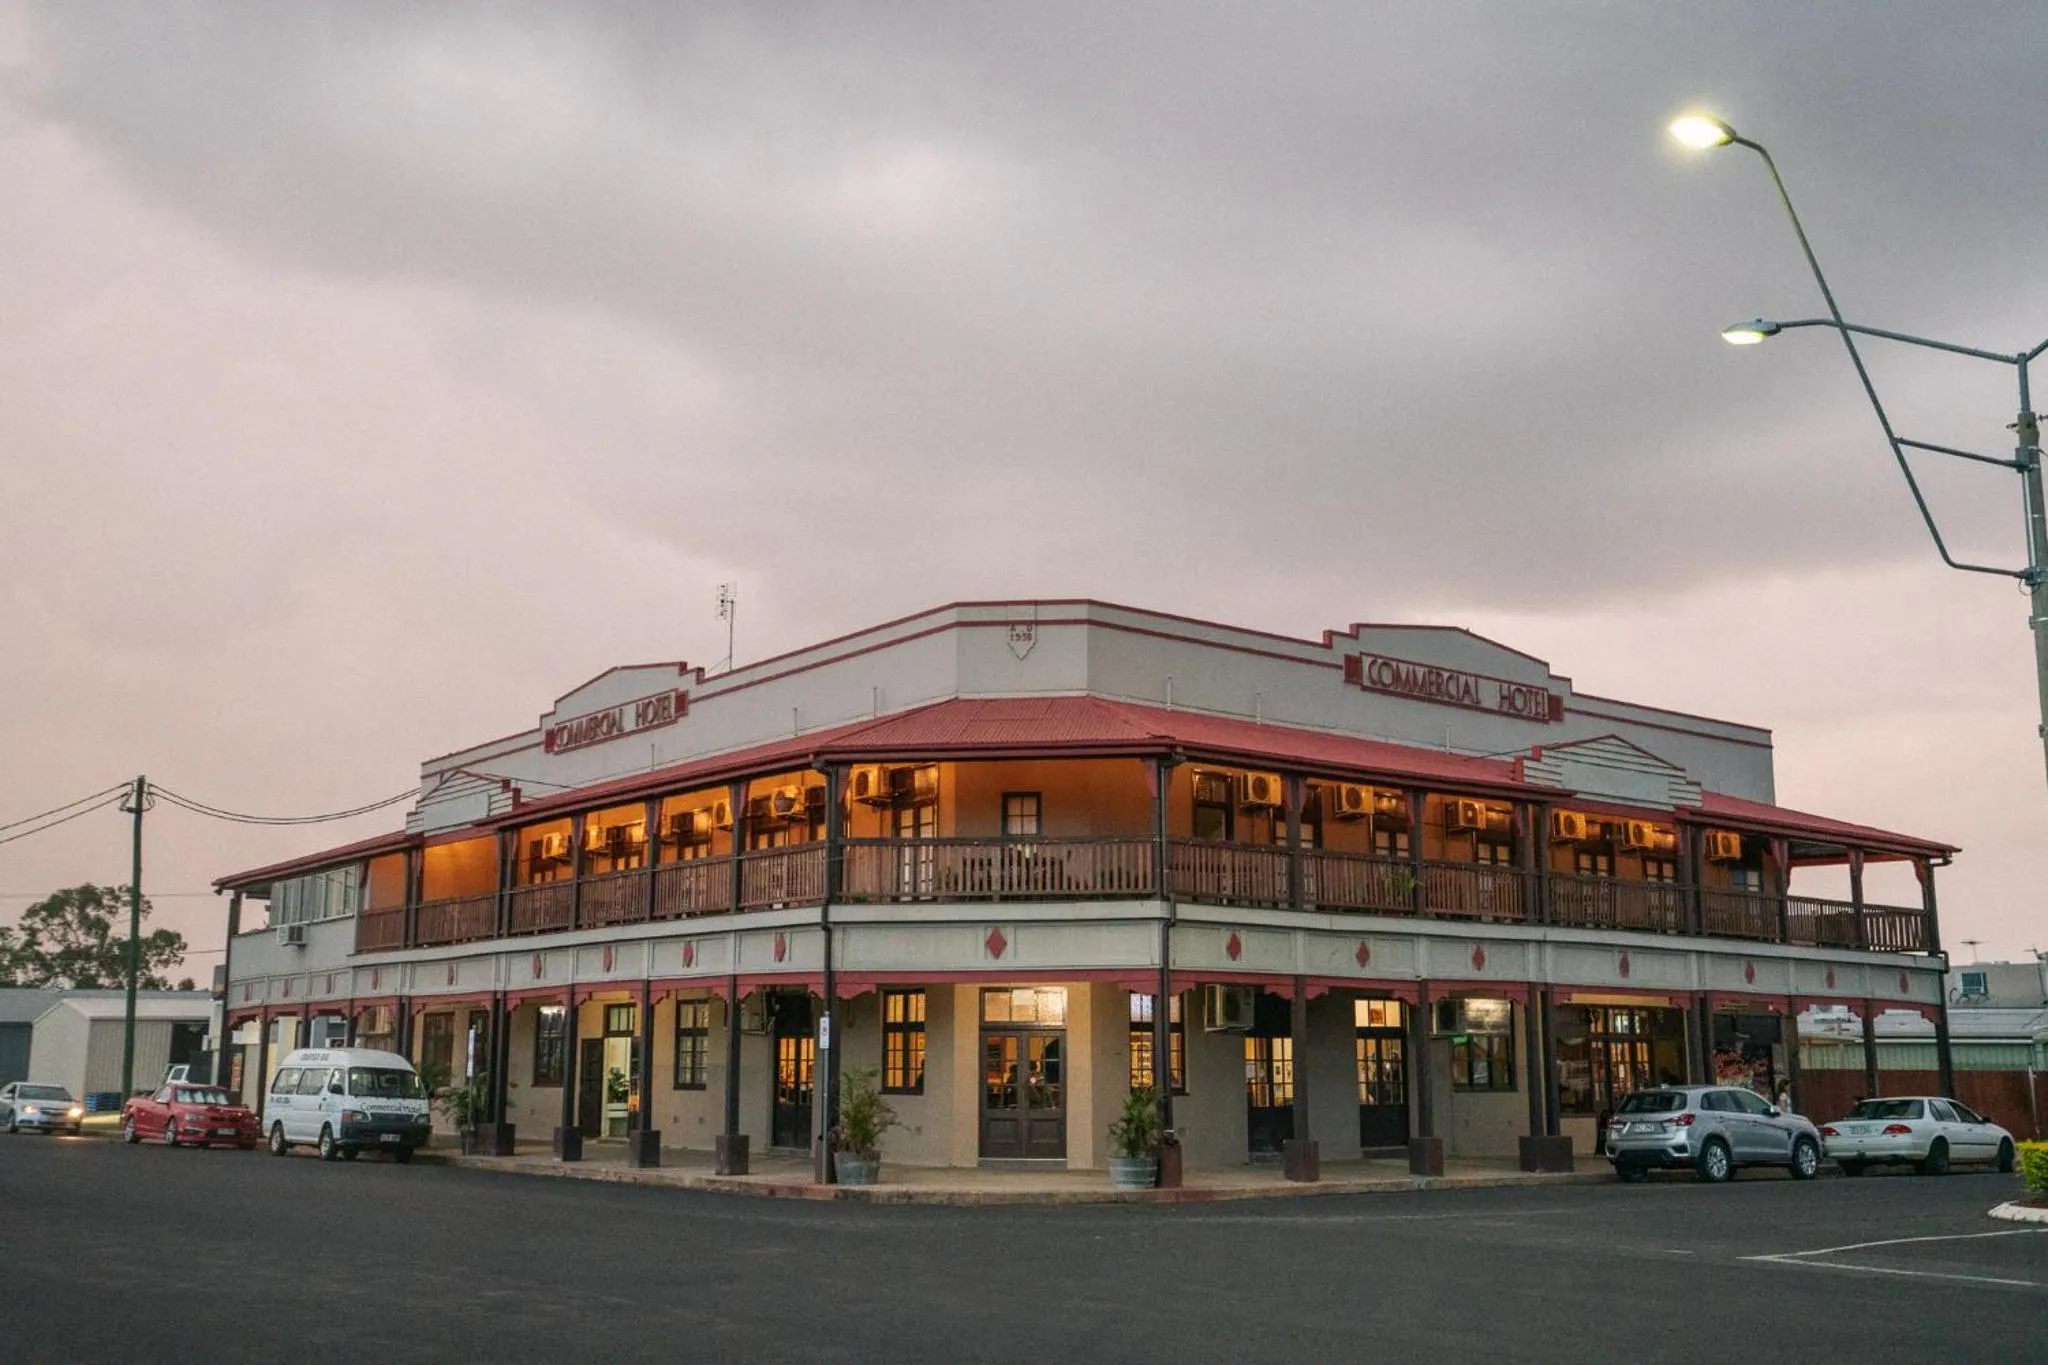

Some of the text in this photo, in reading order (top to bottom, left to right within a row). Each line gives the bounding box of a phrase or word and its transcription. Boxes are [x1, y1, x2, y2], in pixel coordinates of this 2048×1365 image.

[635, 693, 672, 727] HOTEL
[1368, 659, 1548, 718] COMMERCIAL HOTEL
